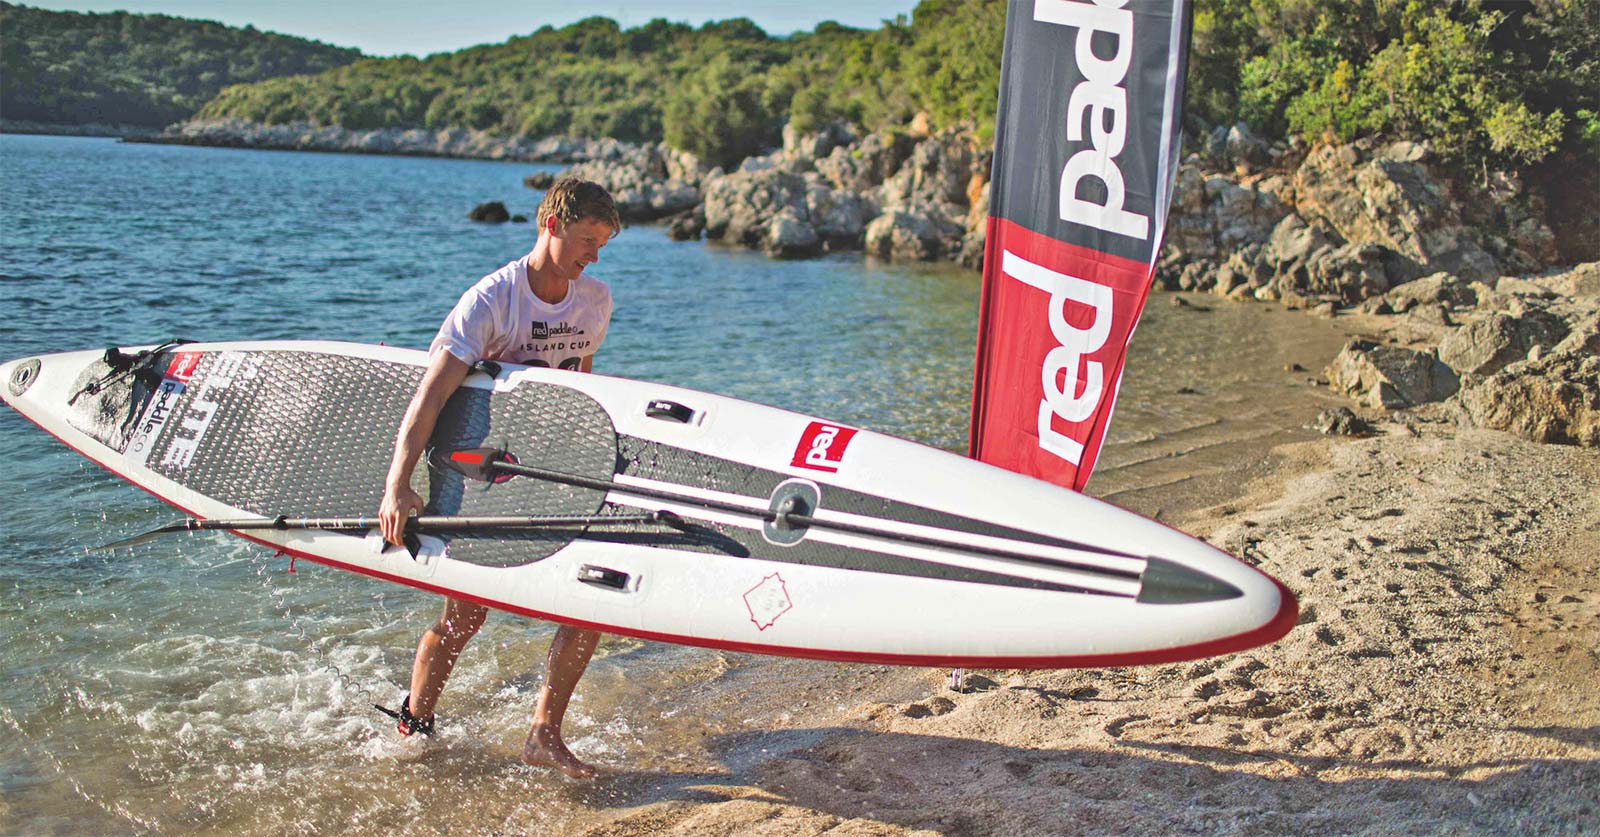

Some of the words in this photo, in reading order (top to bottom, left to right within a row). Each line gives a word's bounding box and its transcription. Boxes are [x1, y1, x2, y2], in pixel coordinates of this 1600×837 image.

[1033, 0, 1150, 240] pad
[520, 342, 565, 352] ISLAND
[570, 340, 591, 350] CUP
[533, 321, 547, 336] red
[172, 352, 193, 382] red
[1002, 249, 1114, 467] red
[804, 425, 842, 471] red
